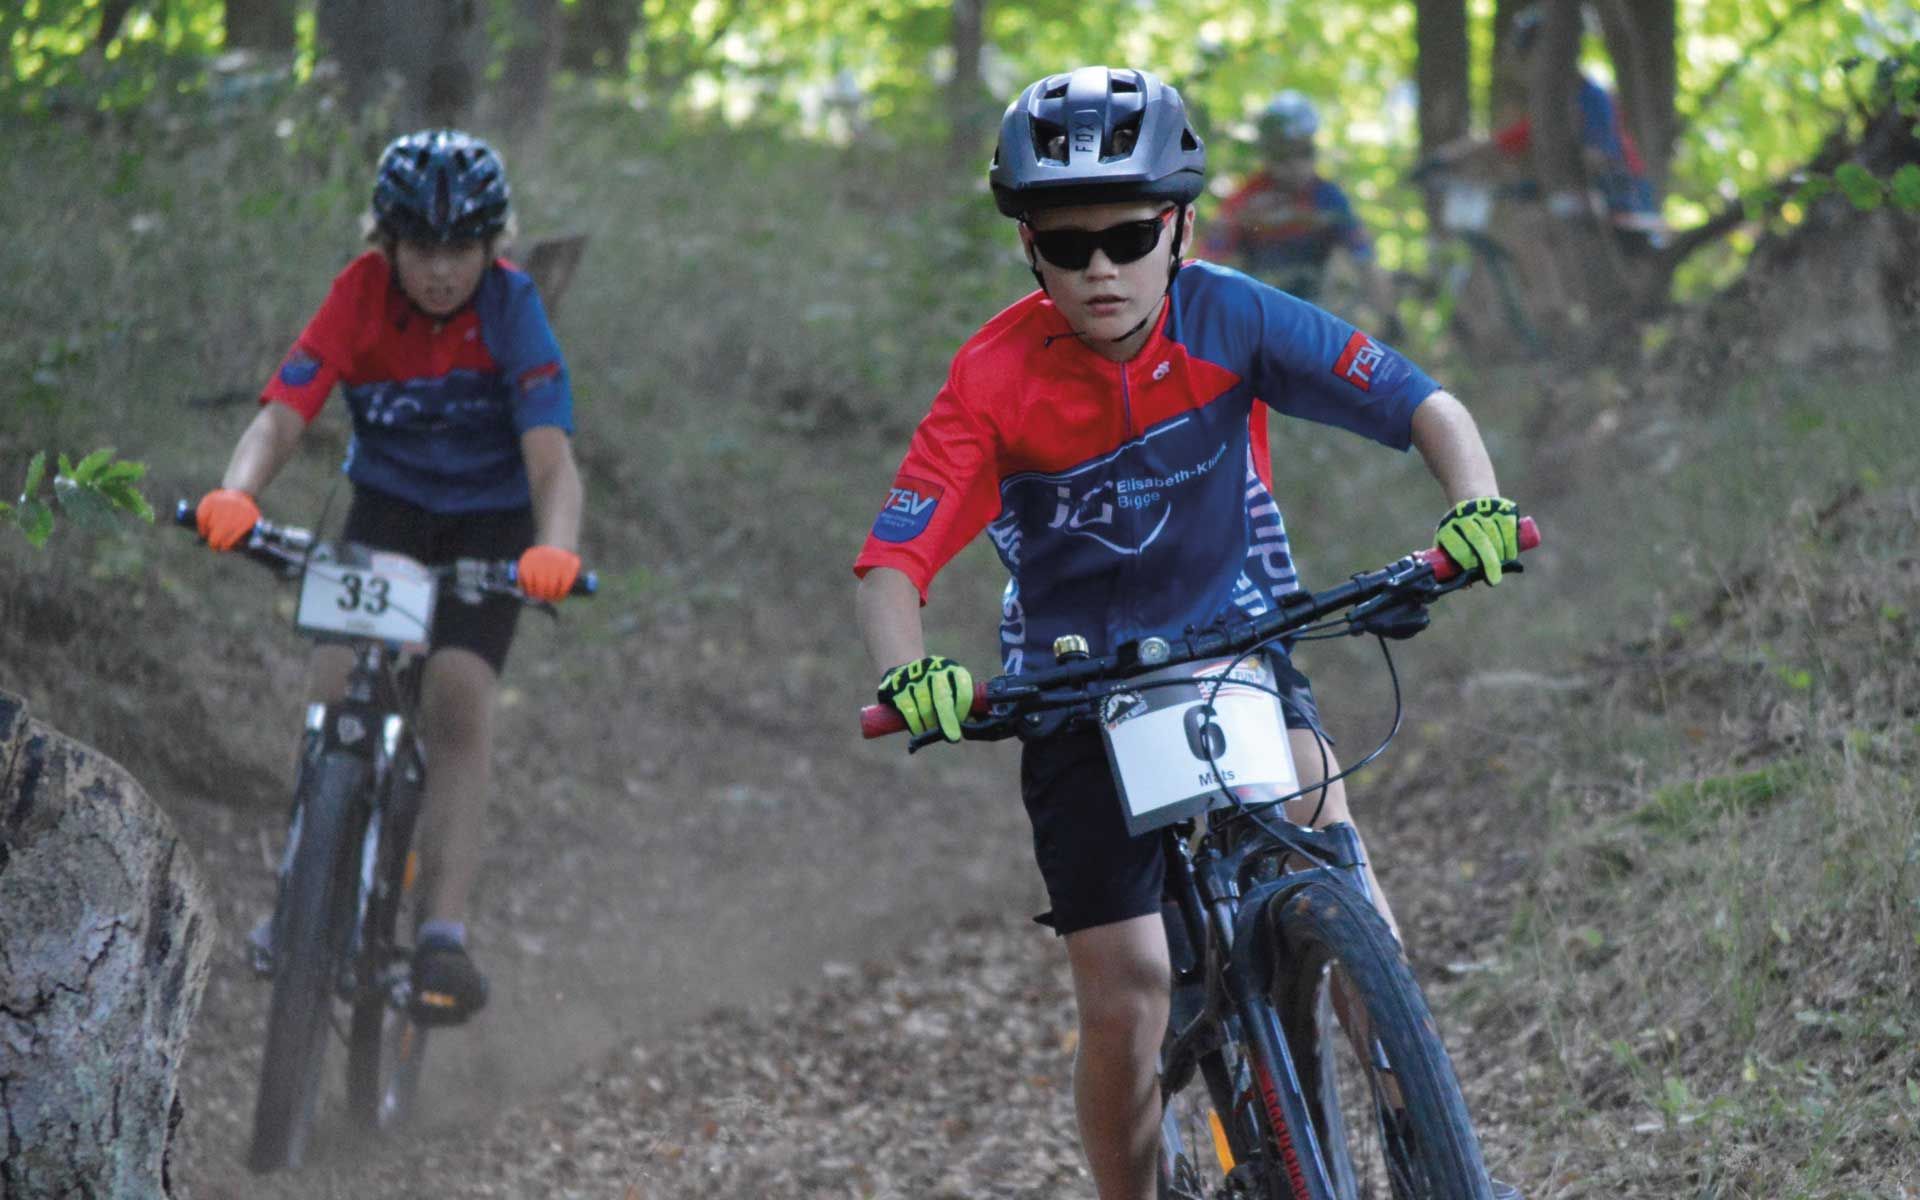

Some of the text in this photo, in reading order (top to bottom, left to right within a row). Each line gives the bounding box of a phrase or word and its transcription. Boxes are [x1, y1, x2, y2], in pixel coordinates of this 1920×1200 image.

[1074, 122, 1094, 152] FOX
[1347, 336, 1385, 382] TSV
[884, 487, 935, 515] TSV
[1118, 491, 1160, 509] Bigge
[1455, 497, 1517, 516] FOX
[336, 572, 391, 618] 33
[879, 655, 946, 691] FOX
[1183, 704, 1227, 762] 6
